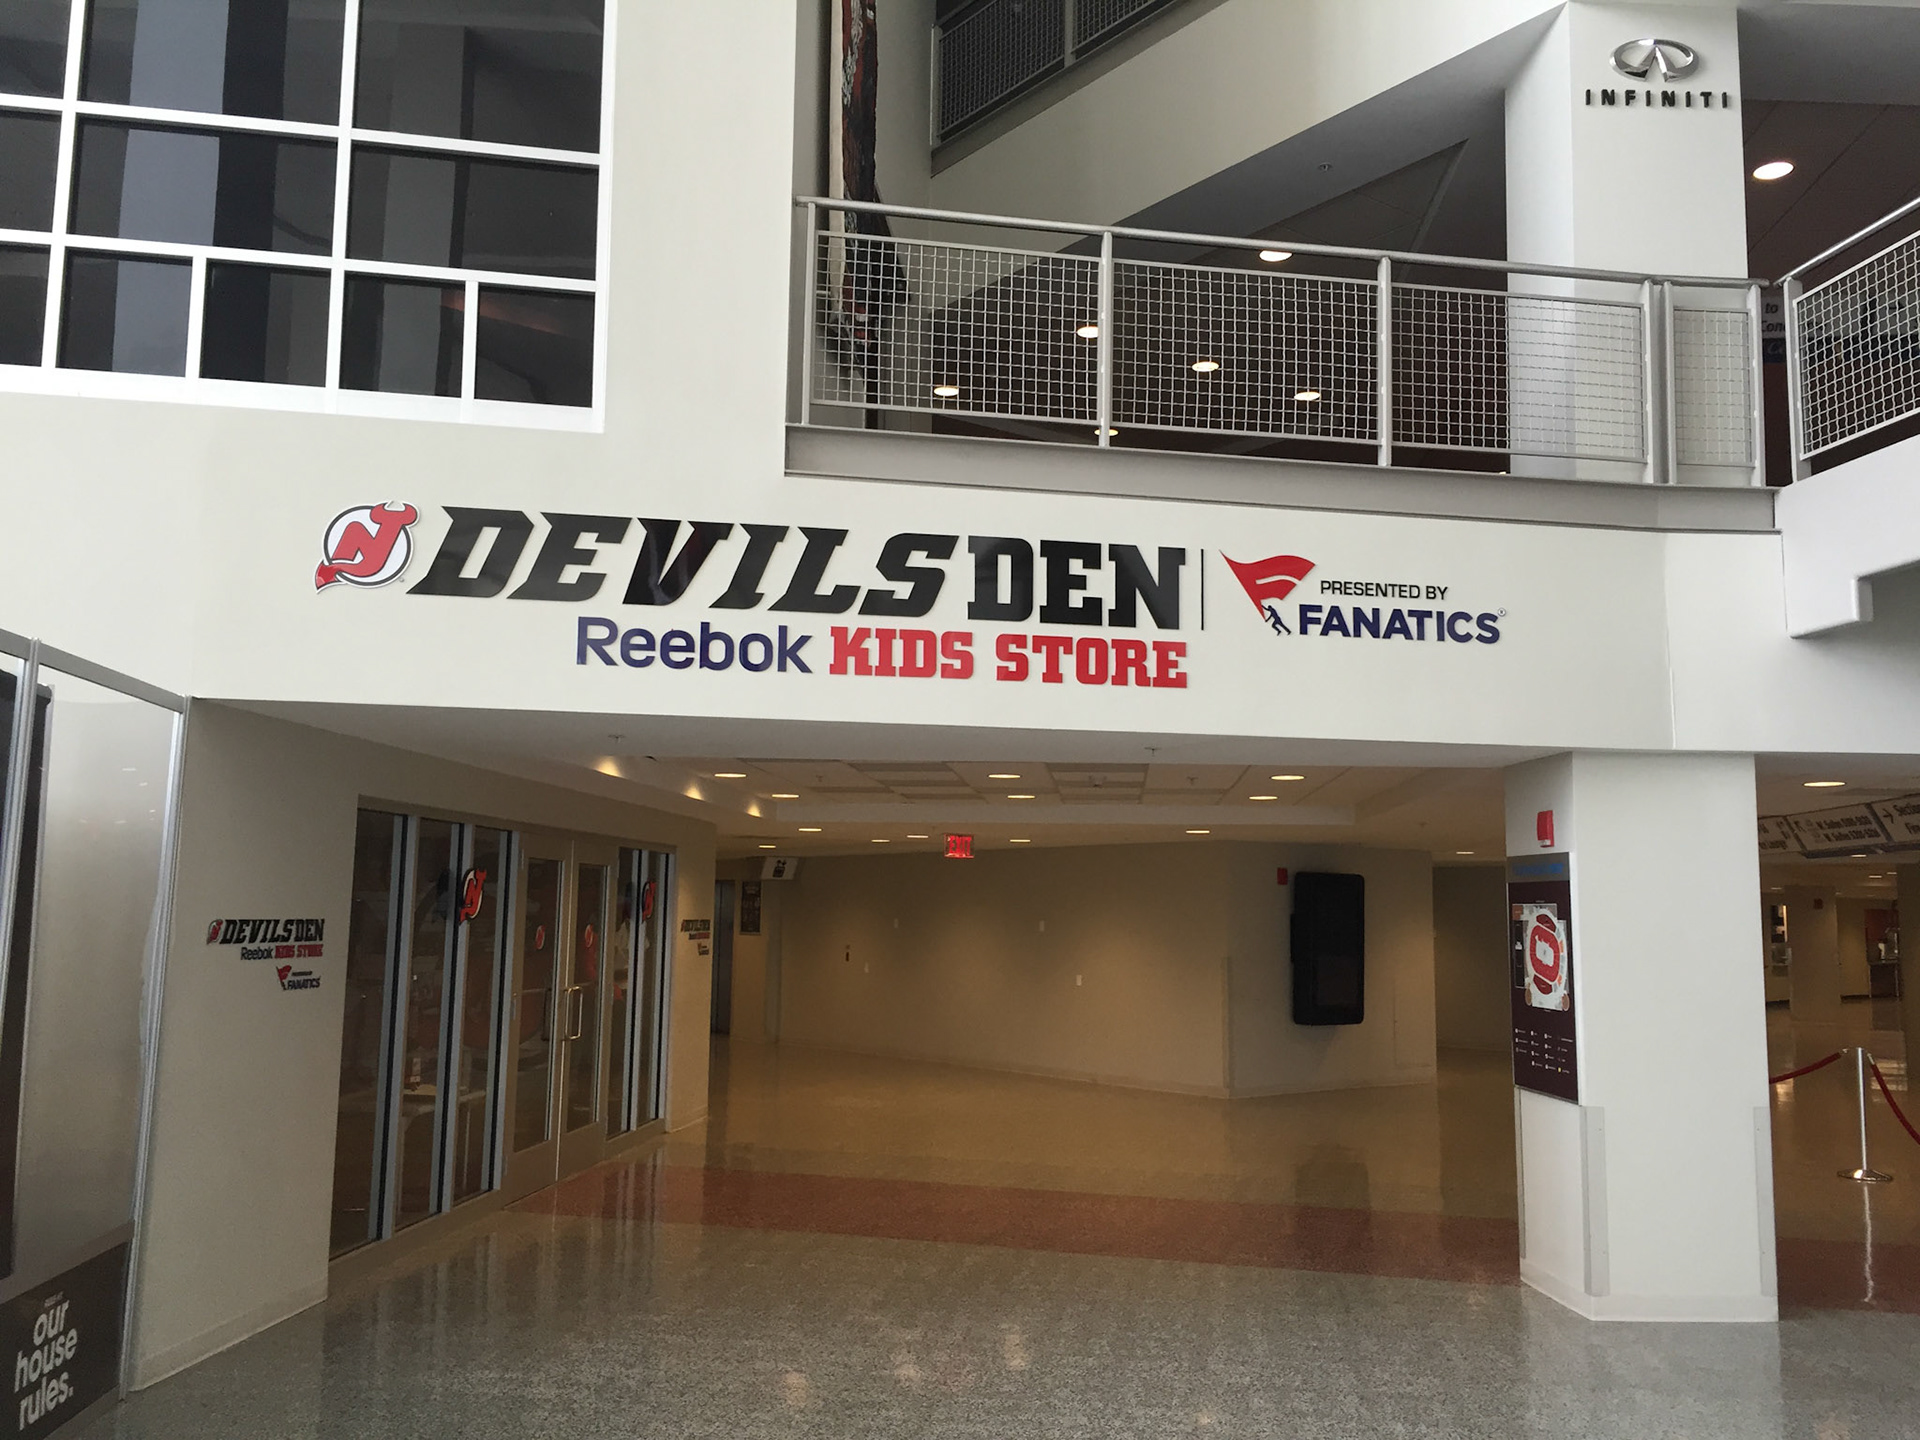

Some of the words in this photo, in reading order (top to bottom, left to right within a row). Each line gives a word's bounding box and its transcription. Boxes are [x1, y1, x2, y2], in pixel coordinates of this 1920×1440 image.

[1585, 88, 1728, 109] INFINITI
[1764, 302, 1779, 314] to
[1320, 580, 1420, 599] PRESENTED
[1426, 585, 1448, 601] BY
[1299, 603, 1501, 645] FANATICS
[576, 616, 813, 674] Reebok
[829, 625, 974, 680] KIDS
[995, 633, 1188, 689] STORE
[240, 946, 274, 960] Reebok
[32, 1299, 70, 1346] our
[14, 1328, 78, 1393] house
[19, 1371, 74, 1431] rules.
